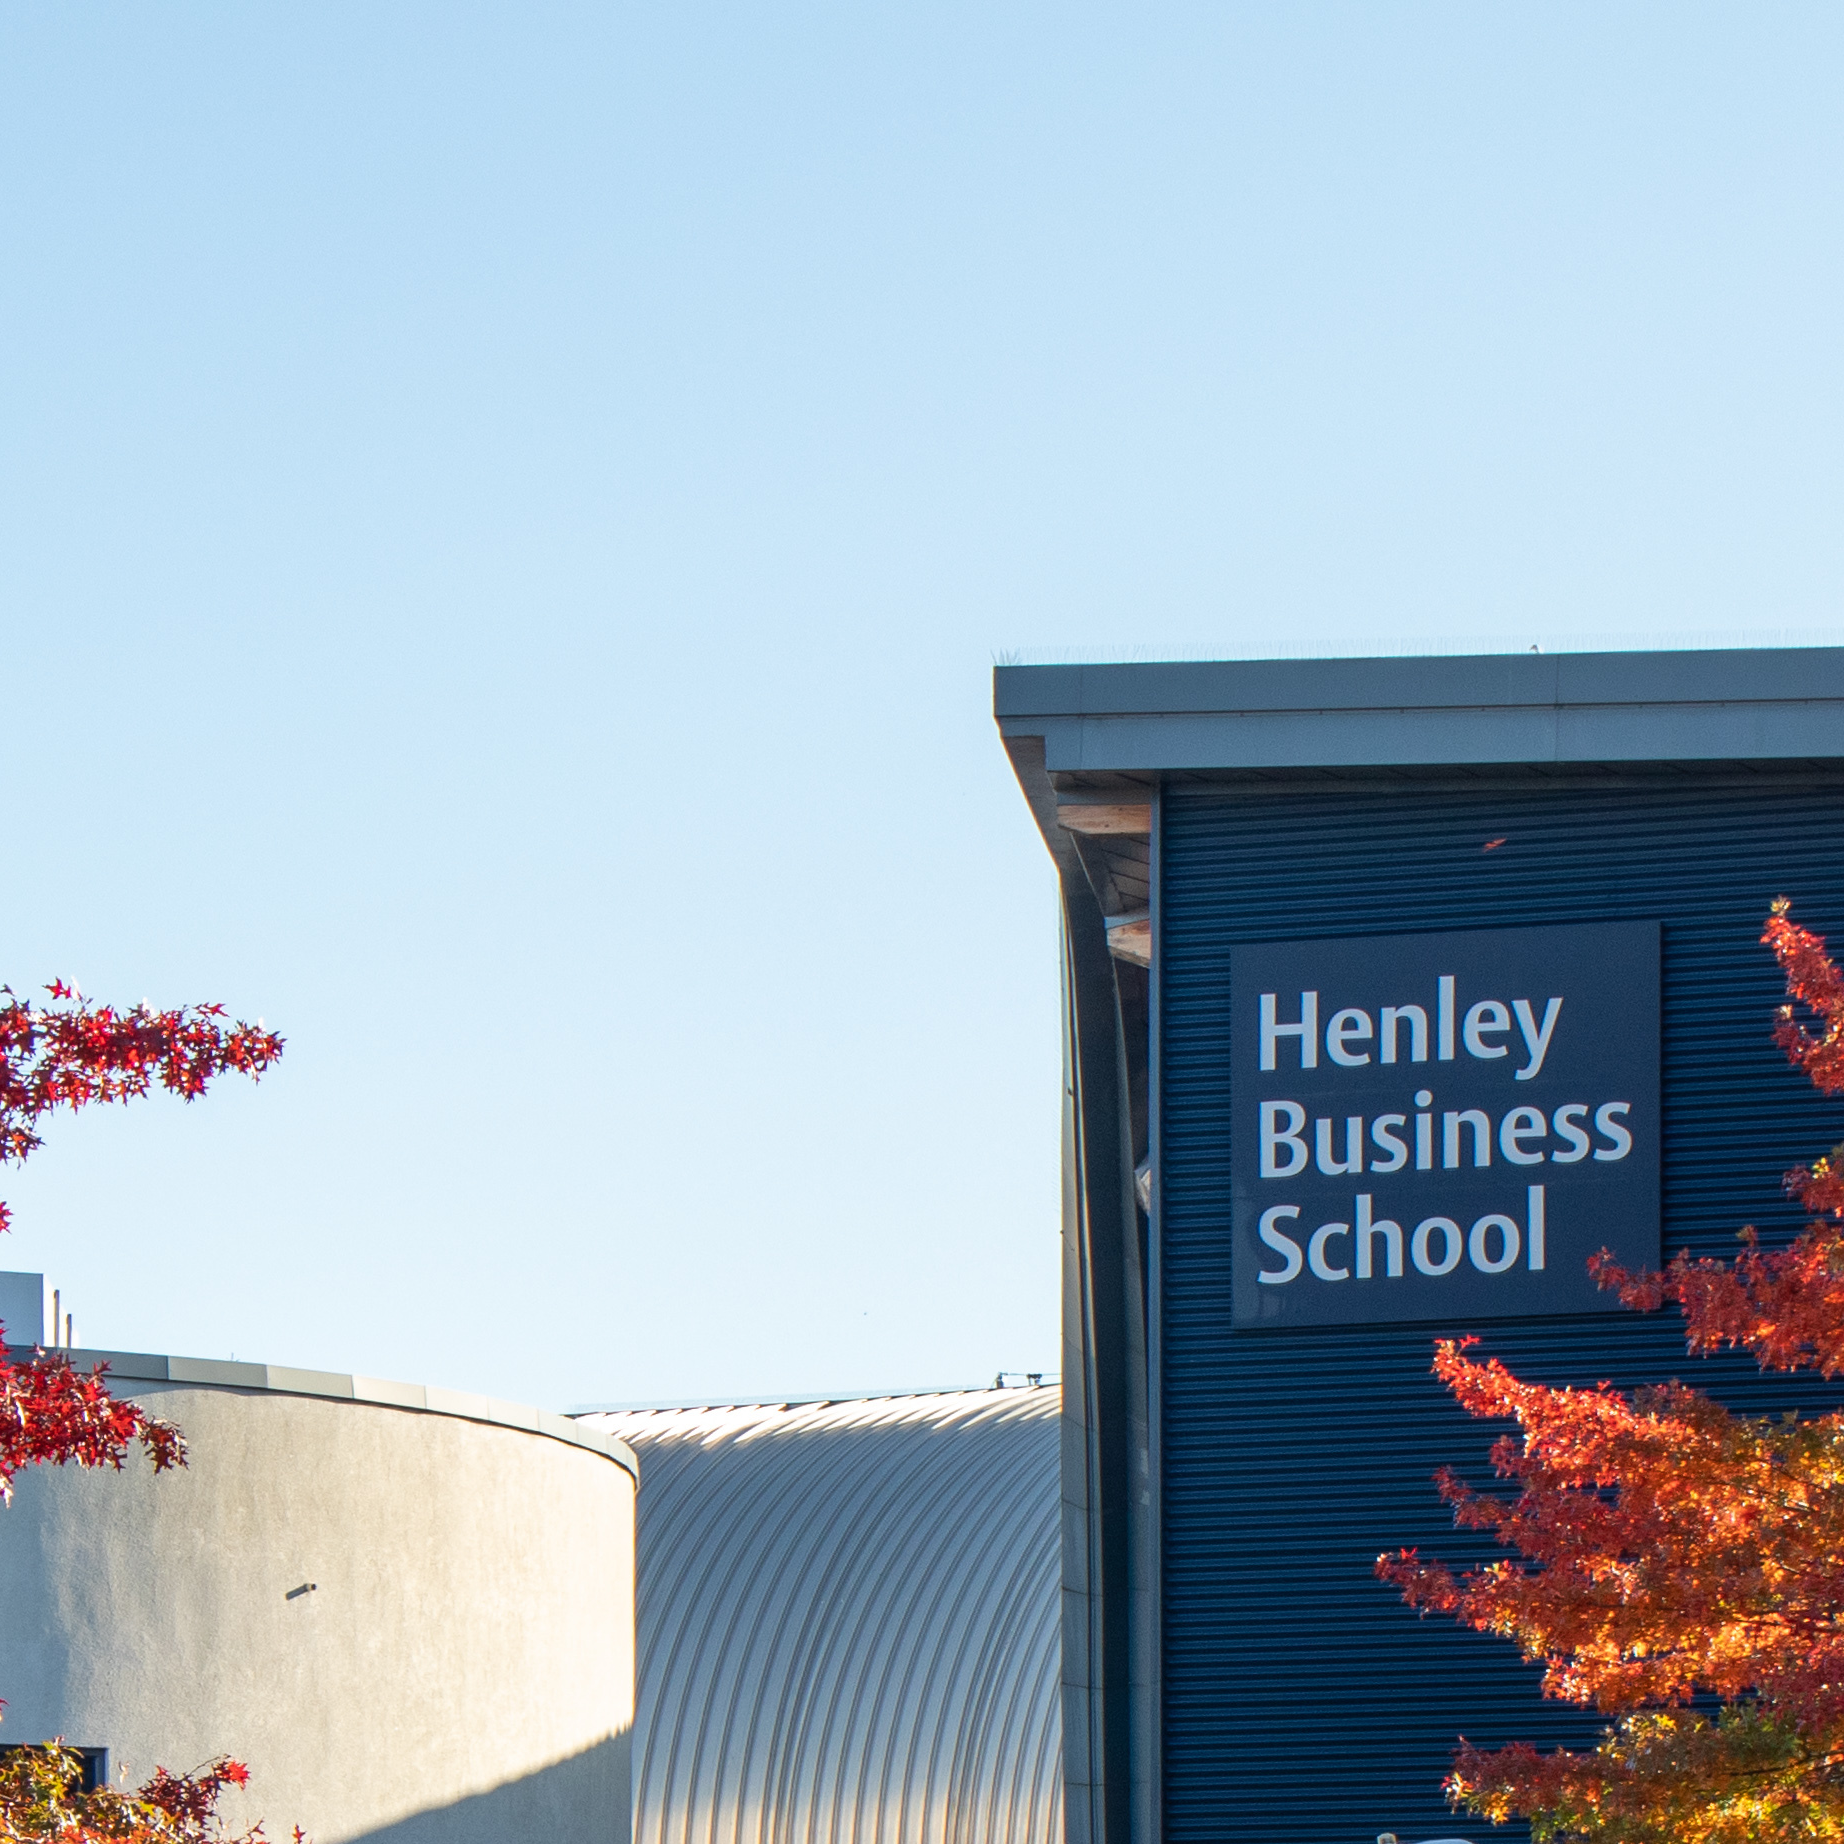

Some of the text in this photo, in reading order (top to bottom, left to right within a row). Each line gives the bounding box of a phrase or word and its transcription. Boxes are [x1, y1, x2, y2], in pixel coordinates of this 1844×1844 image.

[1260, 975, 1563, 1080] Henley
[1260, 1090, 1632, 1179] Business
[1258, 1185, 1545, 1284] School
